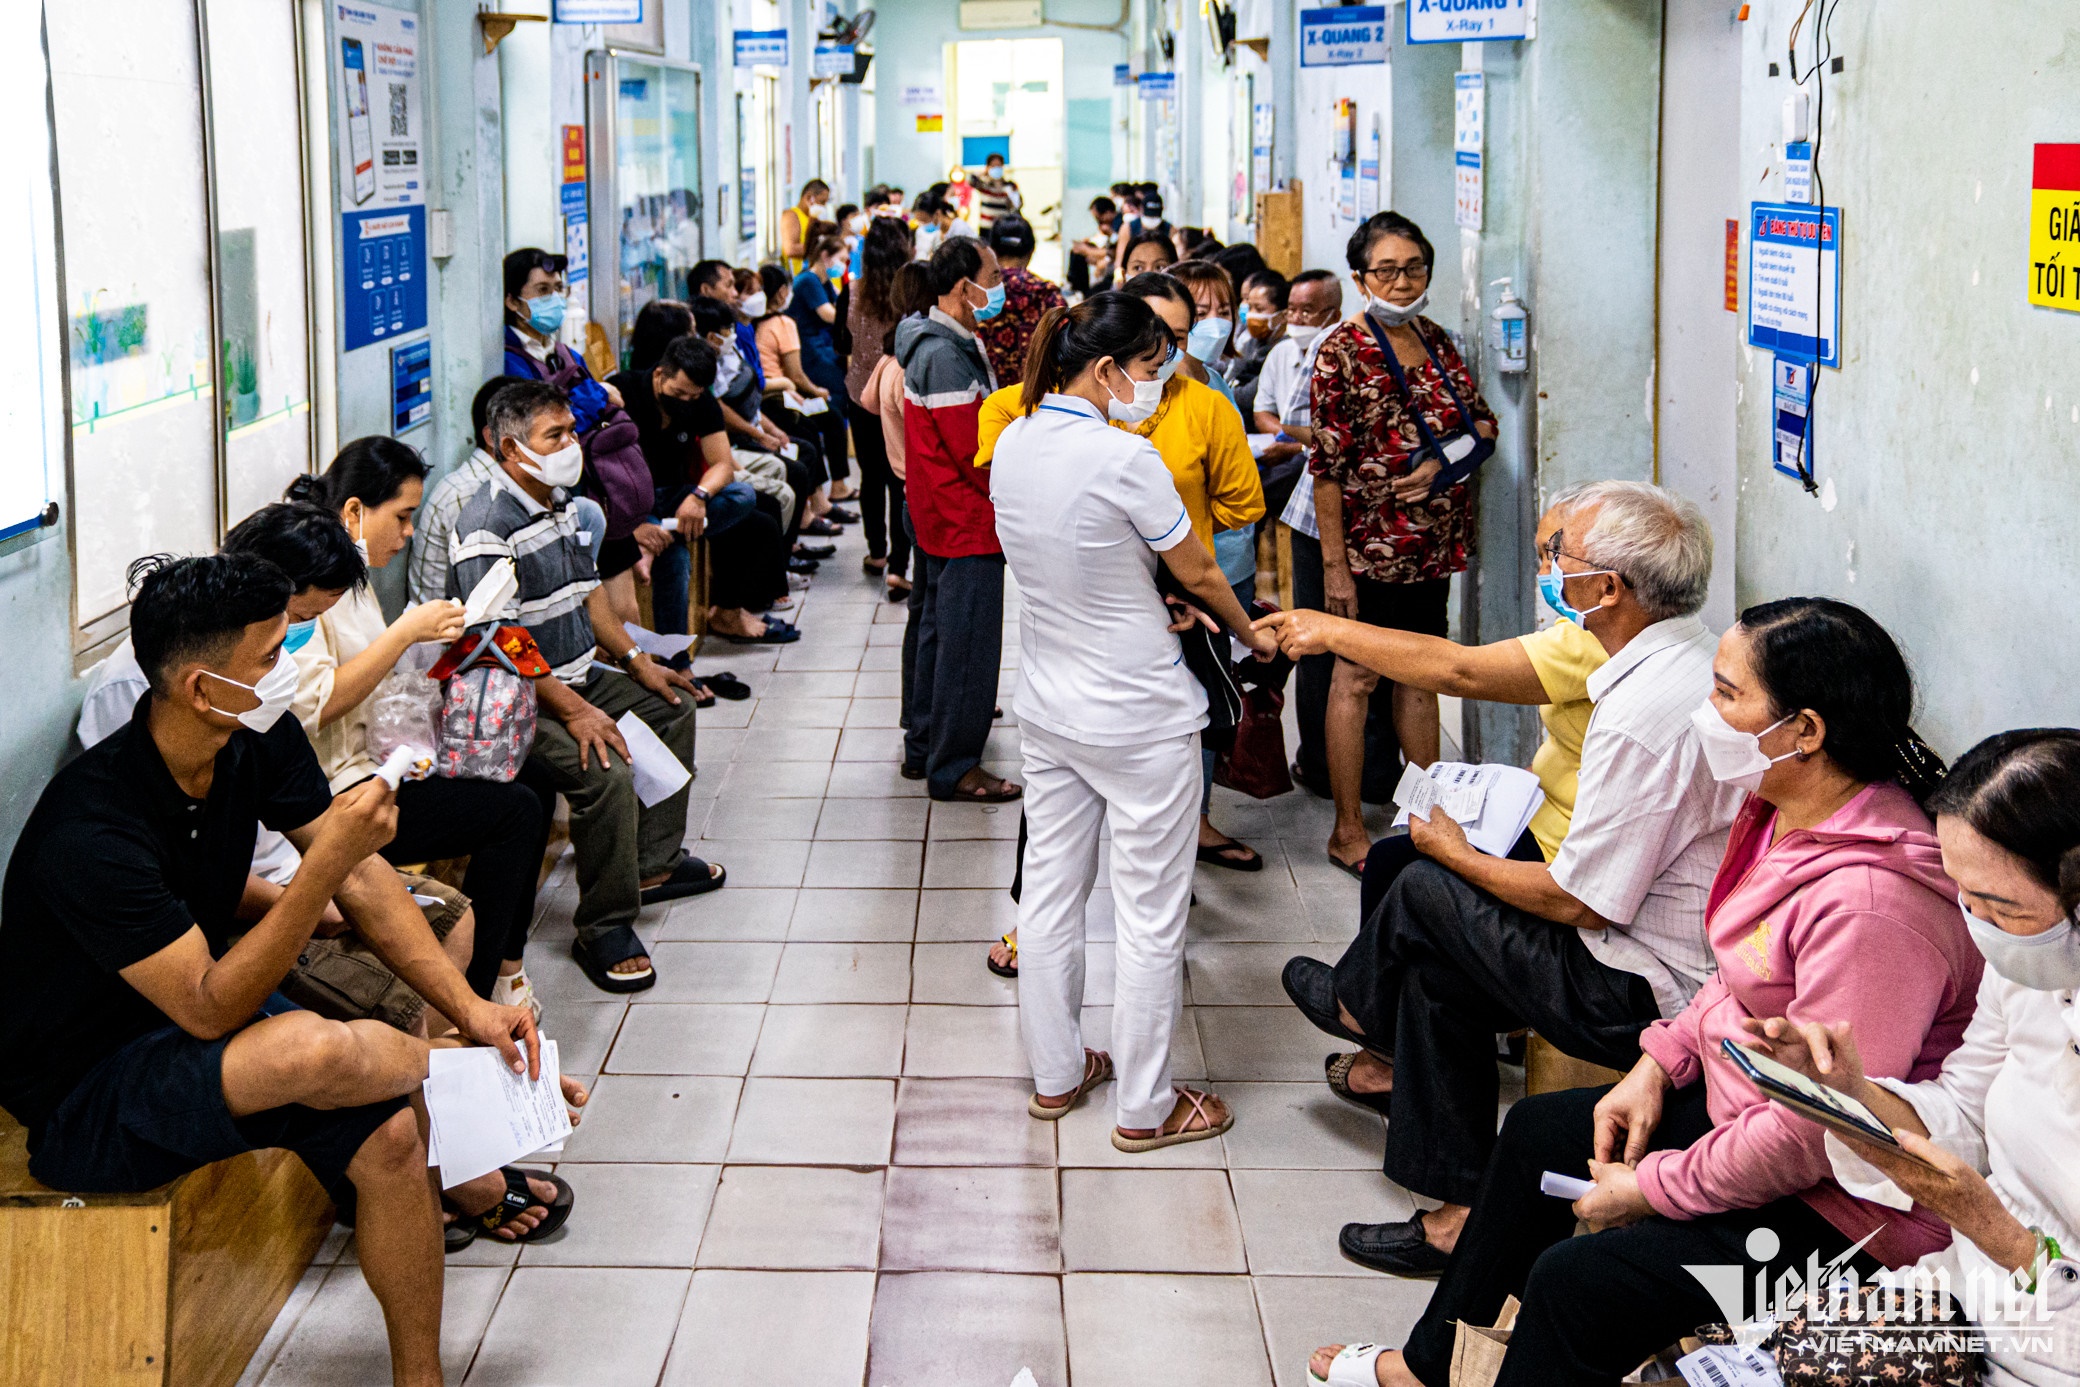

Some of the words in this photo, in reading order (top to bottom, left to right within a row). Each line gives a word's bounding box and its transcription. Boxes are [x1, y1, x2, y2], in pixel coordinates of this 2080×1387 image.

[1446, 19, 1482, 32] X-Ray
[1489, 18, 1494, 30] 1
[1307, 26, 1371, 46] X-QUANG
[1375, 26, 1384, 42] 2
[2034, 252, 2065, 298] TỐI
